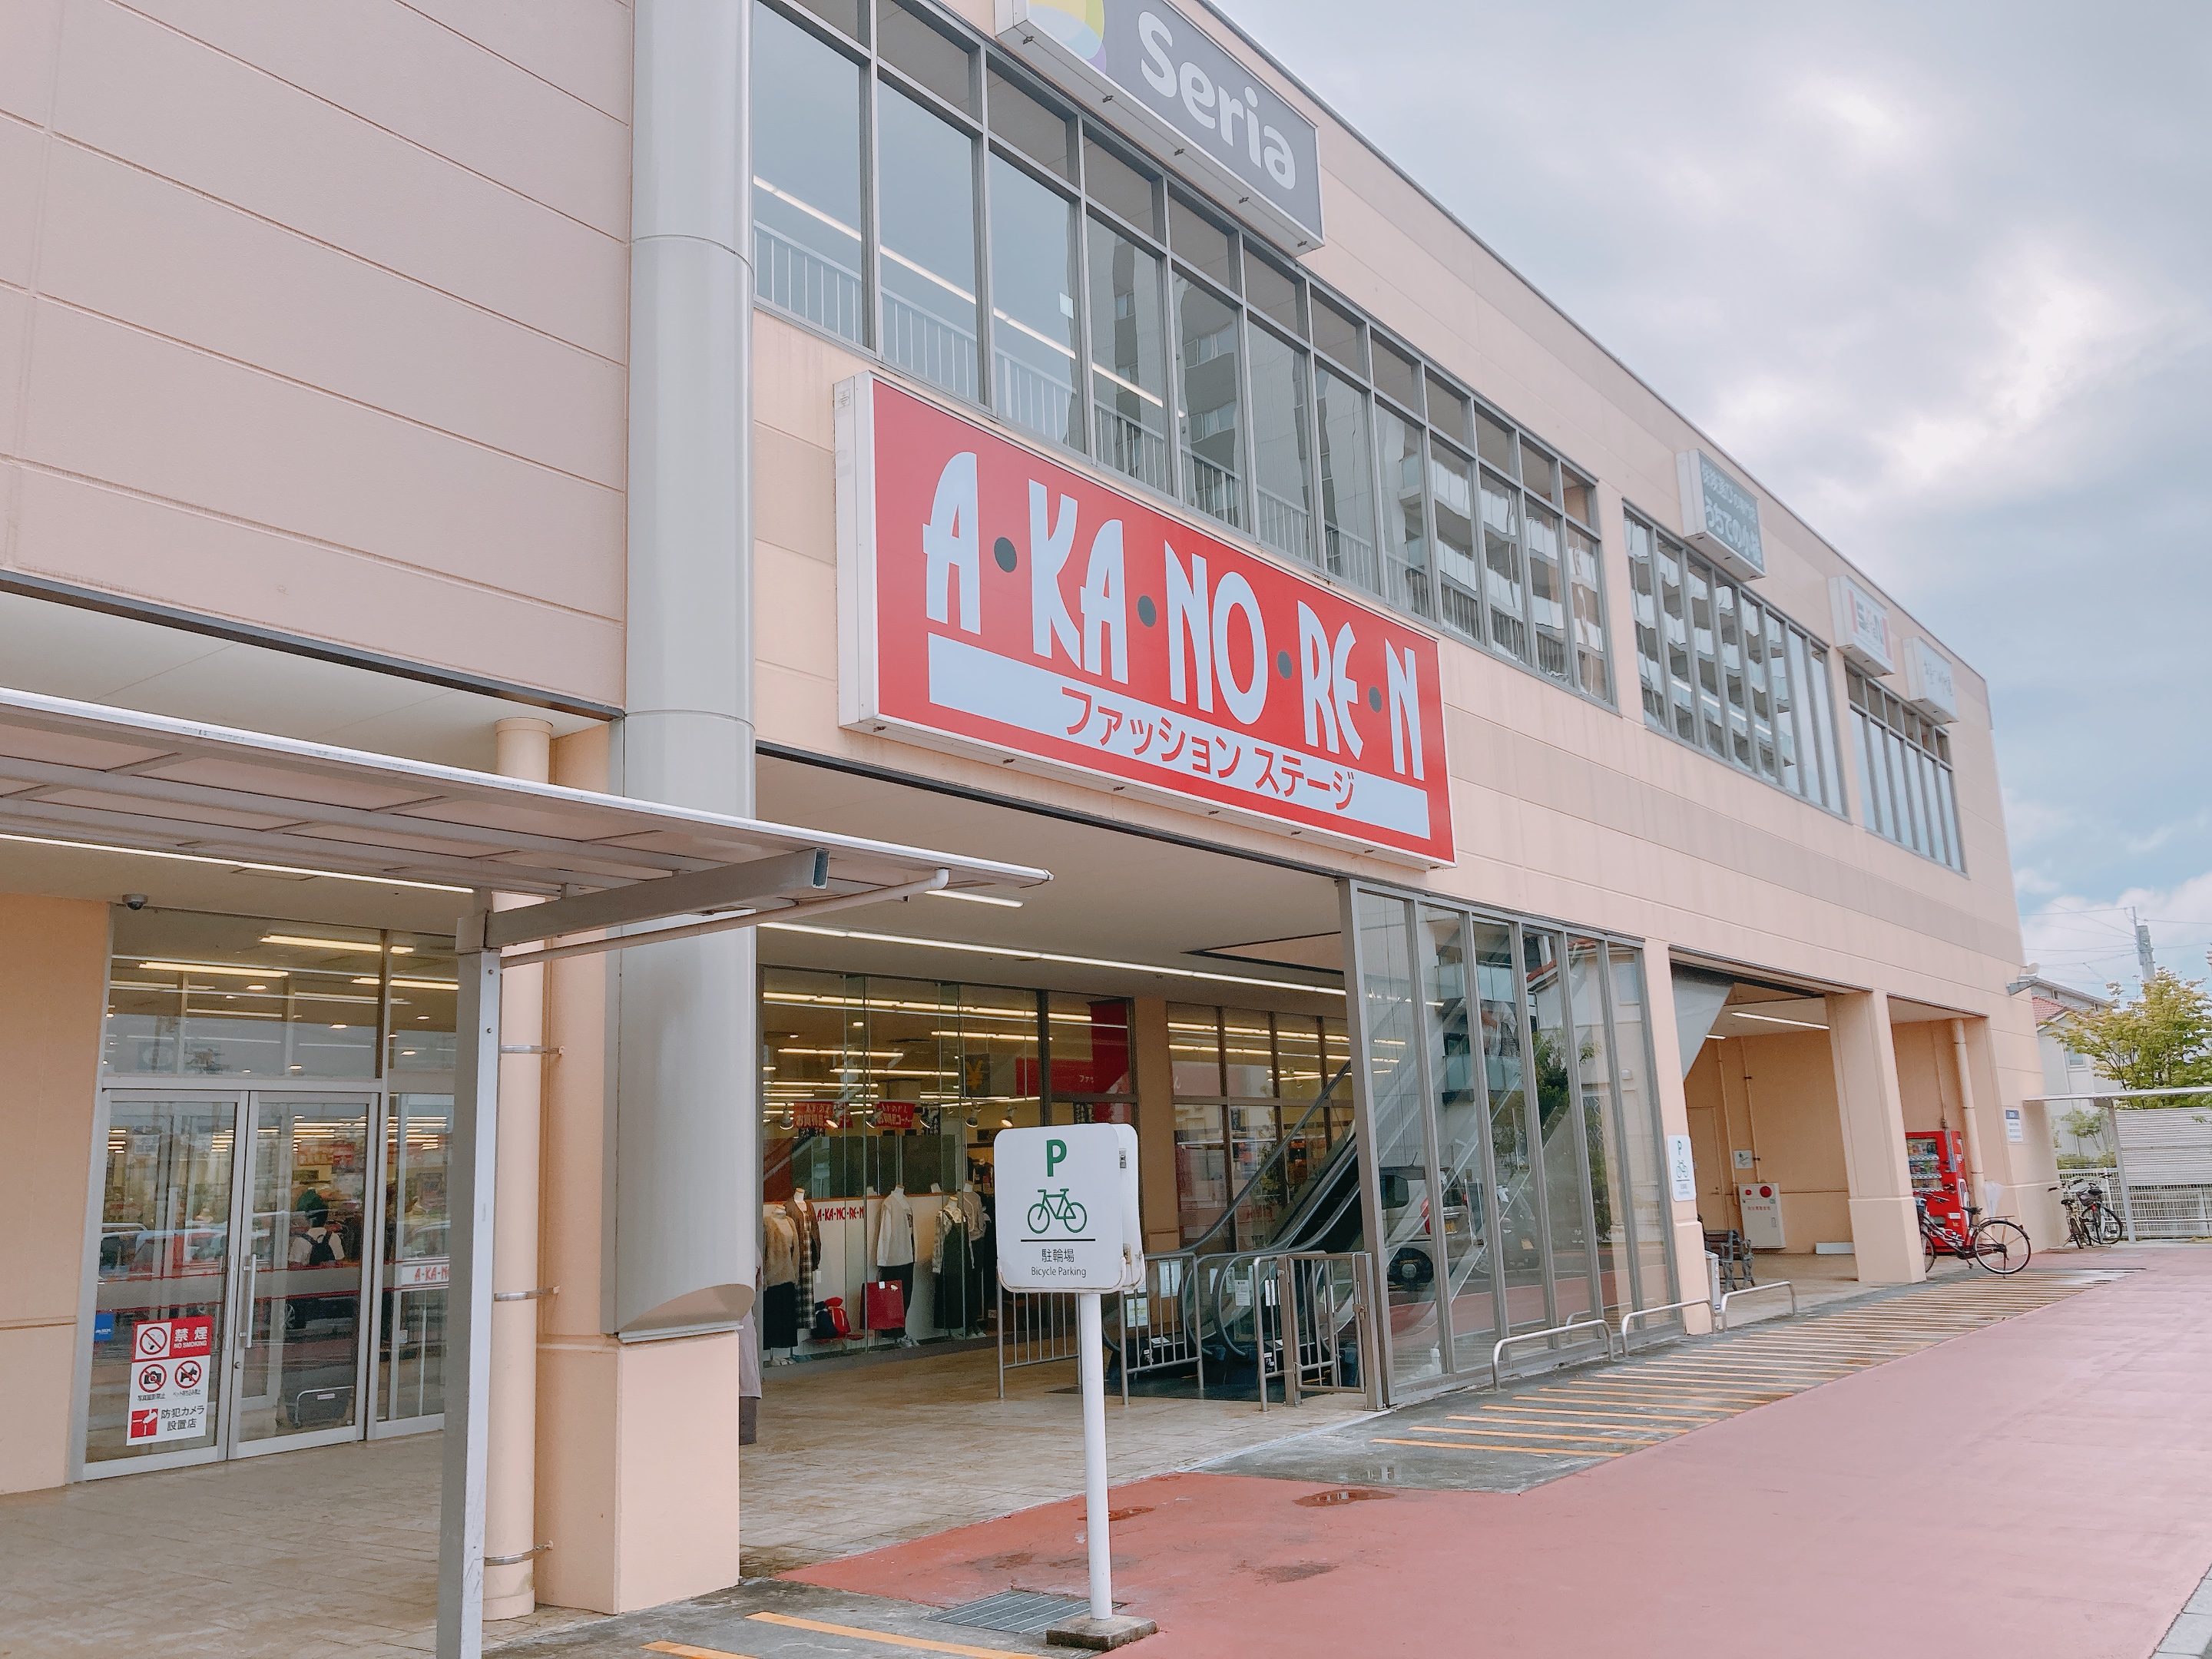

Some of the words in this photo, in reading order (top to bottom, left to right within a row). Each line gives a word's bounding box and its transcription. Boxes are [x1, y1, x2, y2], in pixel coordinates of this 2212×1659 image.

[1137, 11, 1296, 190] Seria
[1061, 686, 1241, 779] ファッション
[1254, 747, 1355, 811] ステージ
[1045, 1139, 1068, 1177] P
[1041, 1248, 1075, 1263] 駐輪場
[1031, 1267, 1057, 1278] Bicycle
[1058, 1267, 1087, 1279] Parking
[183, 1340, 207, 1349] SMOKING
[161, 1405, 205, 1419] 防犯カメラ
[167, 1417, 197, 1432] 設置店
